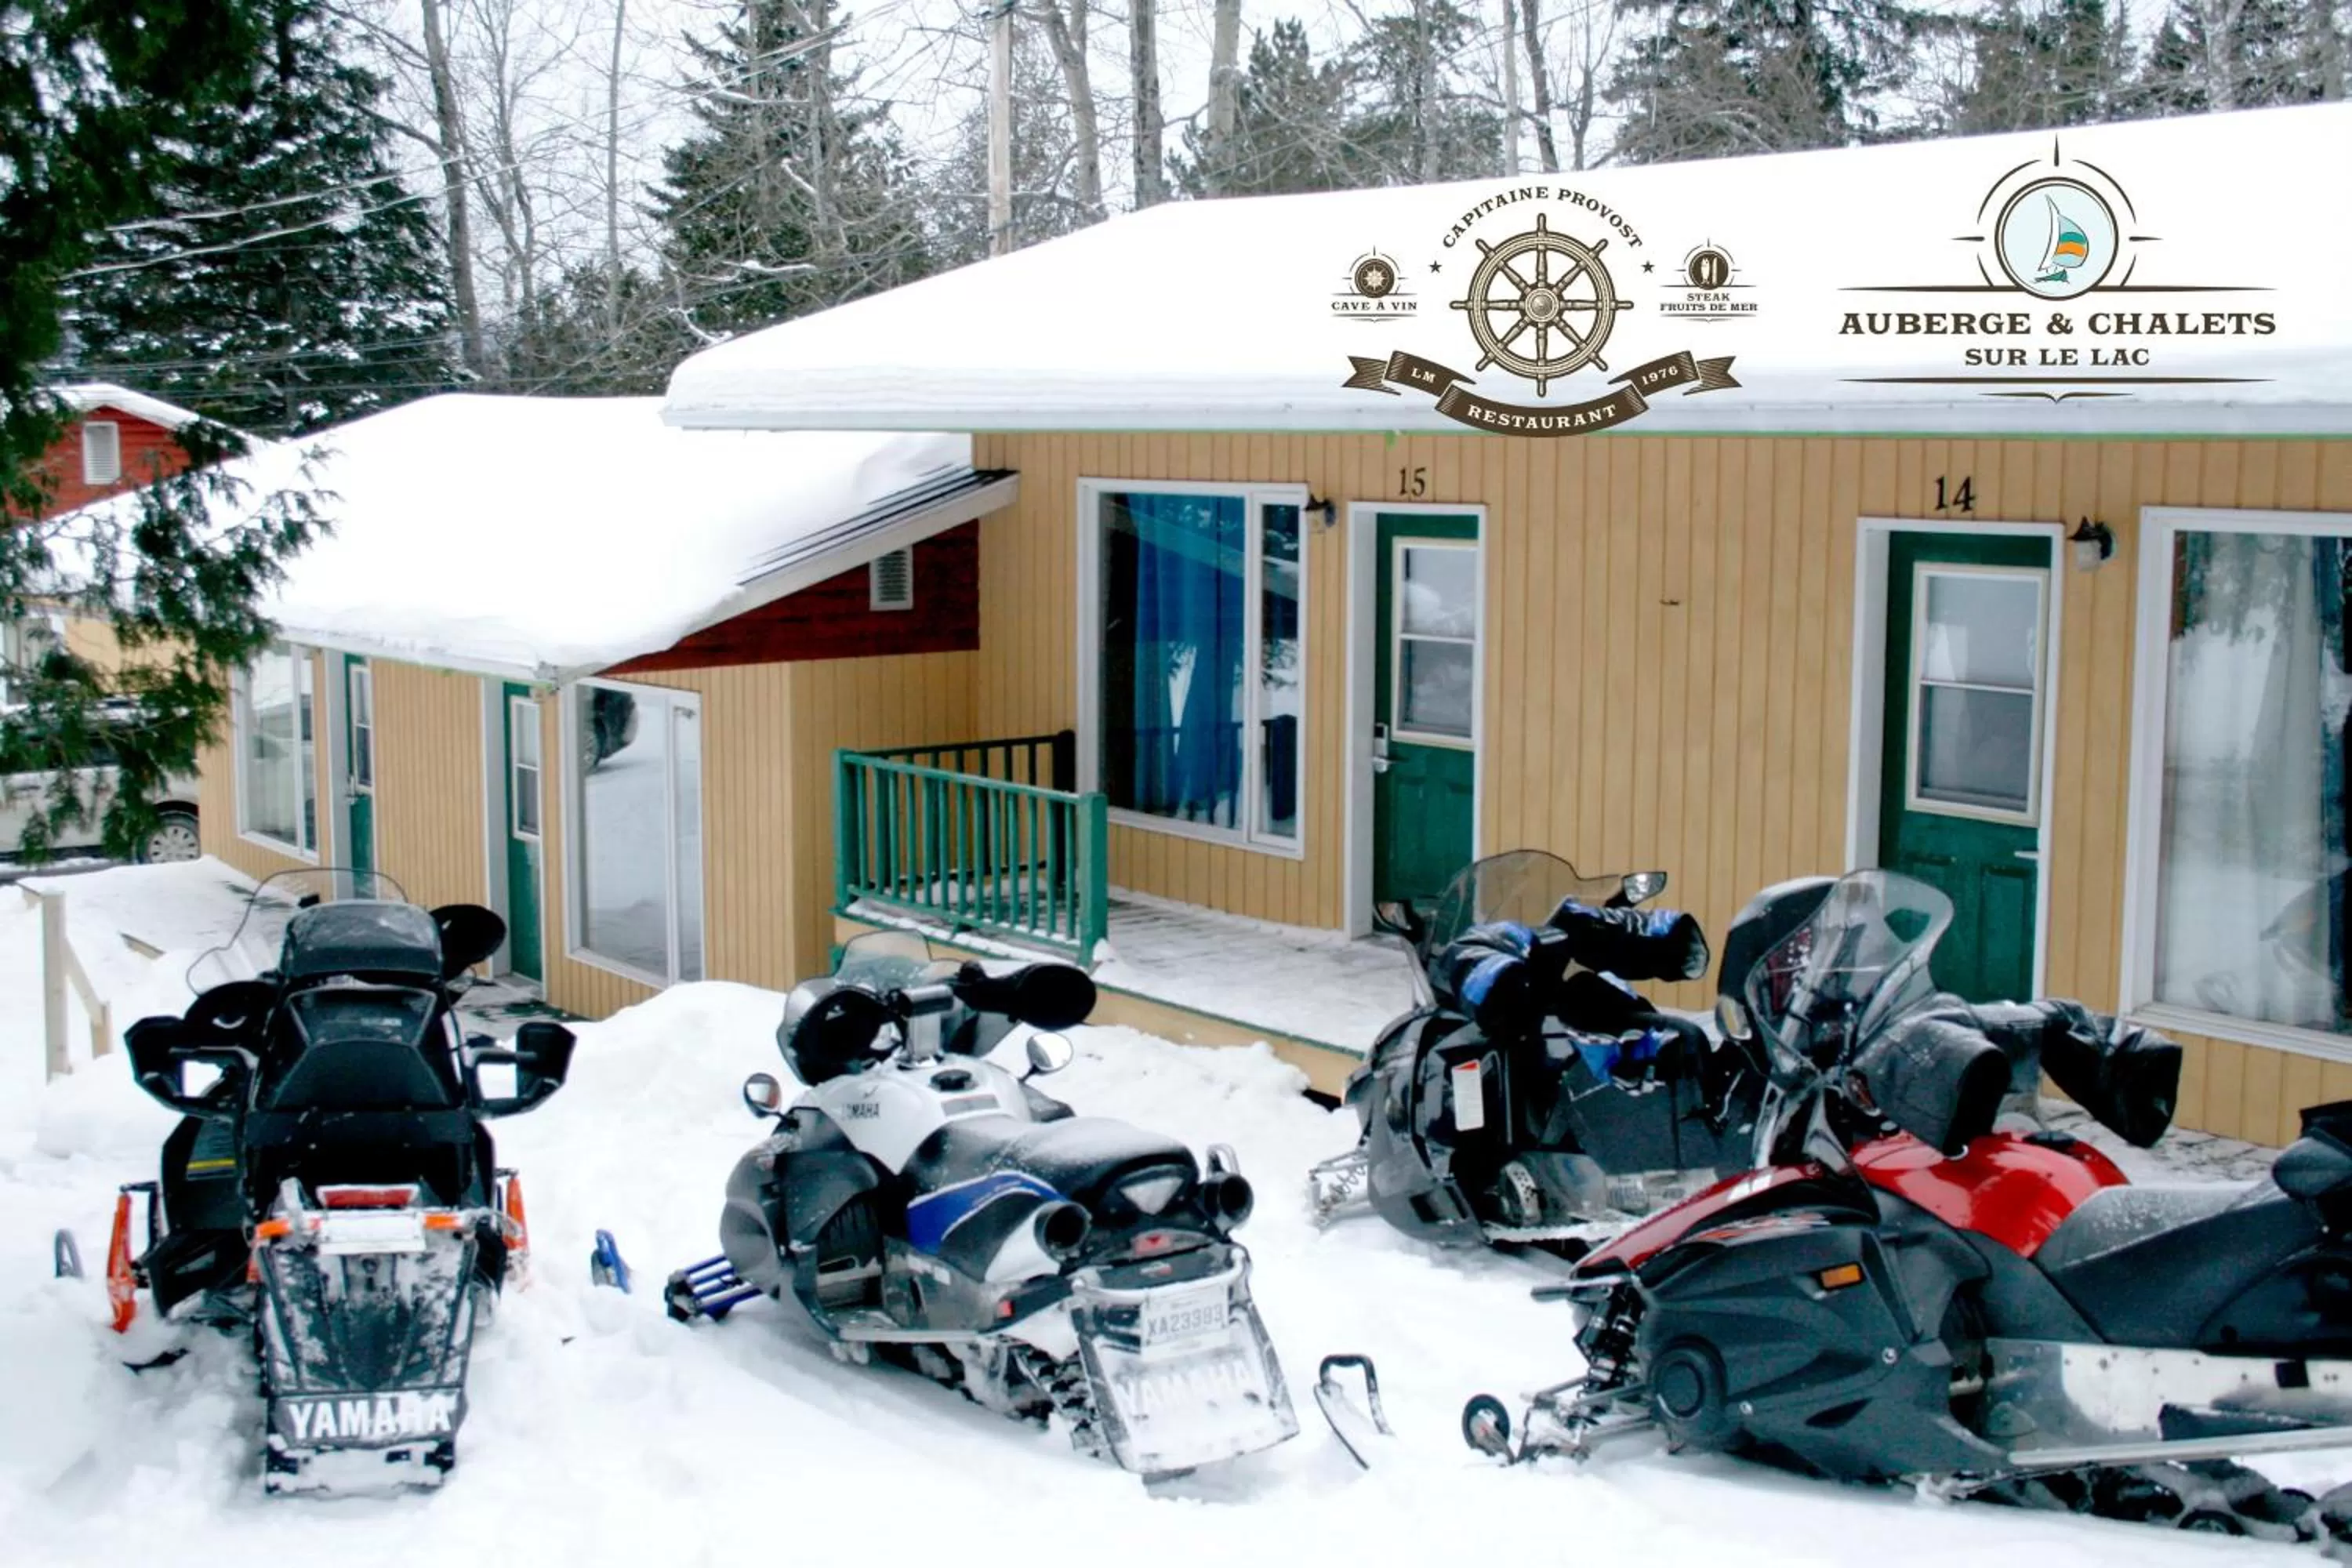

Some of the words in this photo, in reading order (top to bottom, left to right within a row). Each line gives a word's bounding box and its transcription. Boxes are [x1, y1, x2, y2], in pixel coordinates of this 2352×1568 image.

[1399, 466, 1427, 498] 15
[1934, 475, 1976, 513] 14
[288, 1395, 452, 1440] YAMAHA
